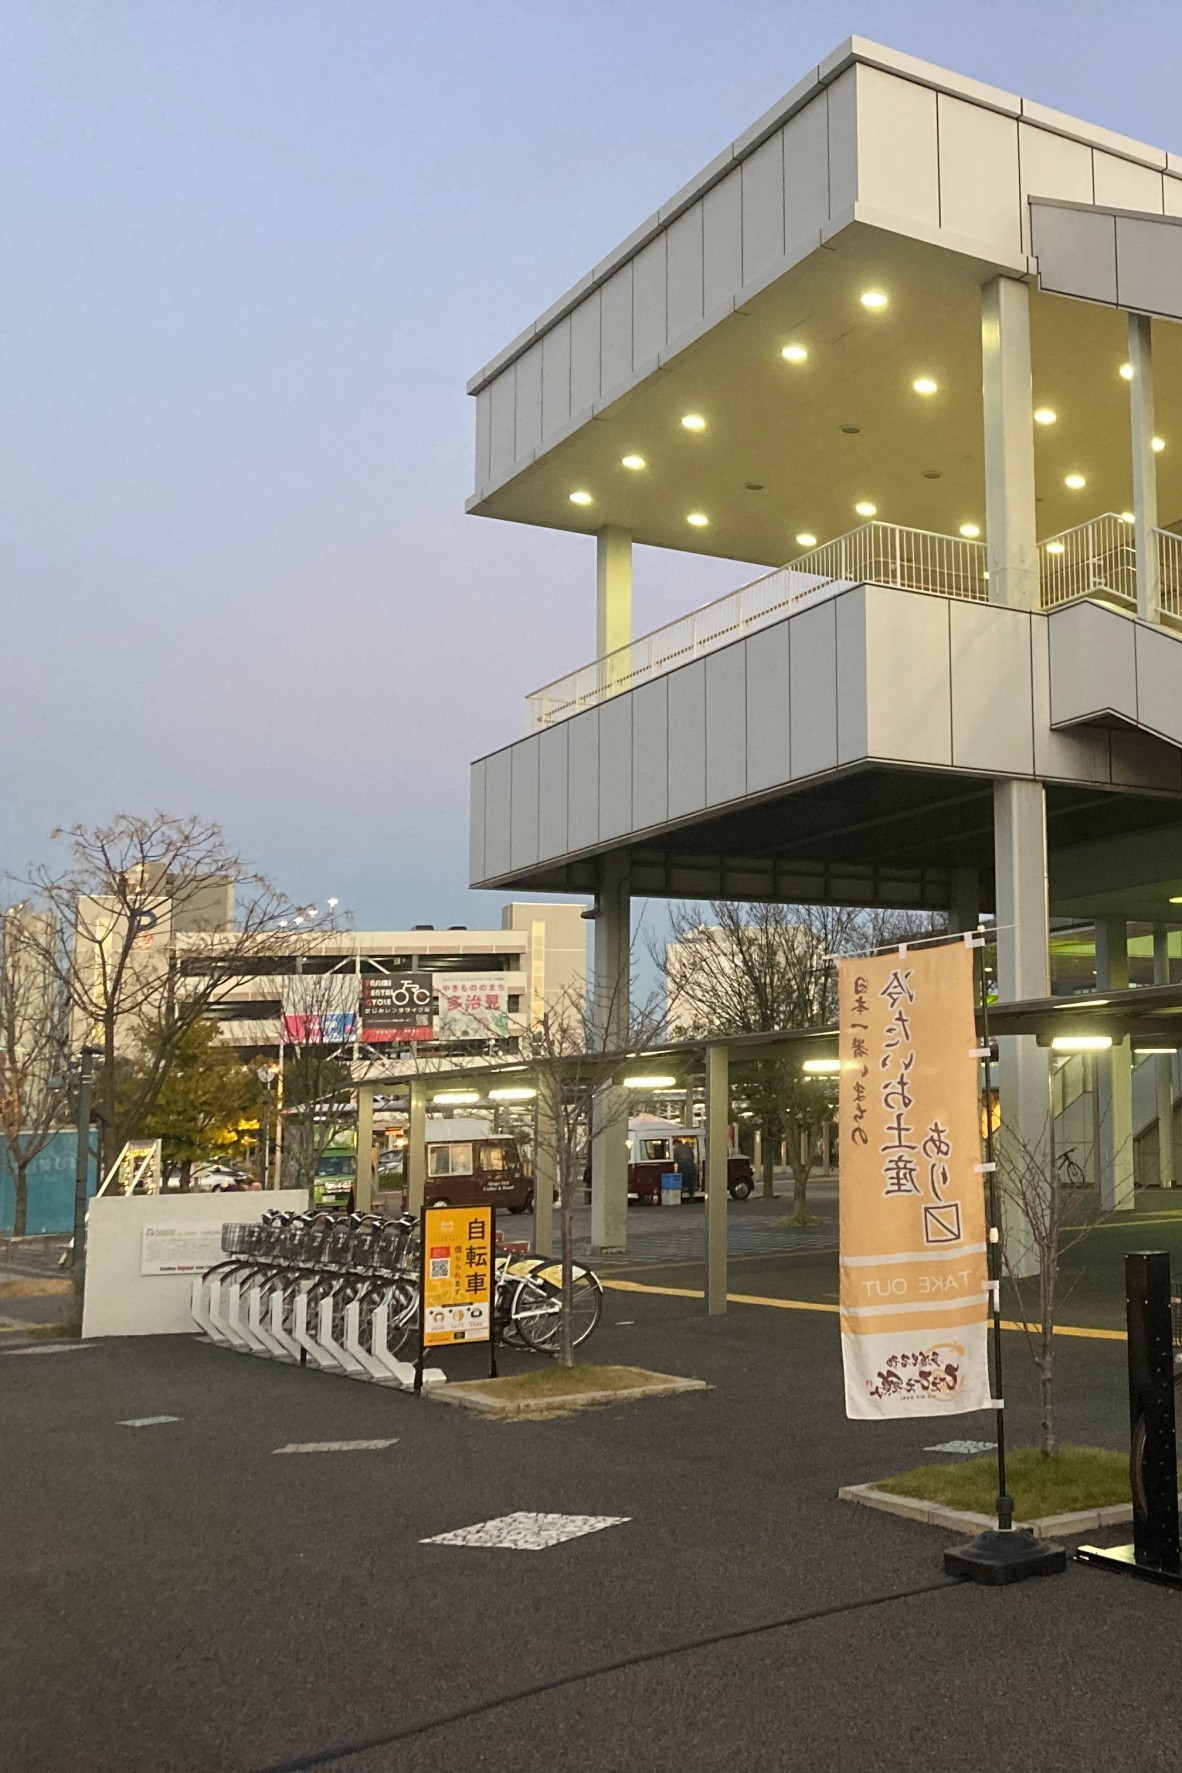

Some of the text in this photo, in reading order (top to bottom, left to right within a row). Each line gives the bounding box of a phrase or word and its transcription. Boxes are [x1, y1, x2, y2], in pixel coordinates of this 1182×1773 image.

[442, 984, 505, 993] やきもののまち
[447, 994, 500, 1011] 多治見
[465, 1217, 487, 1295] 自転車
